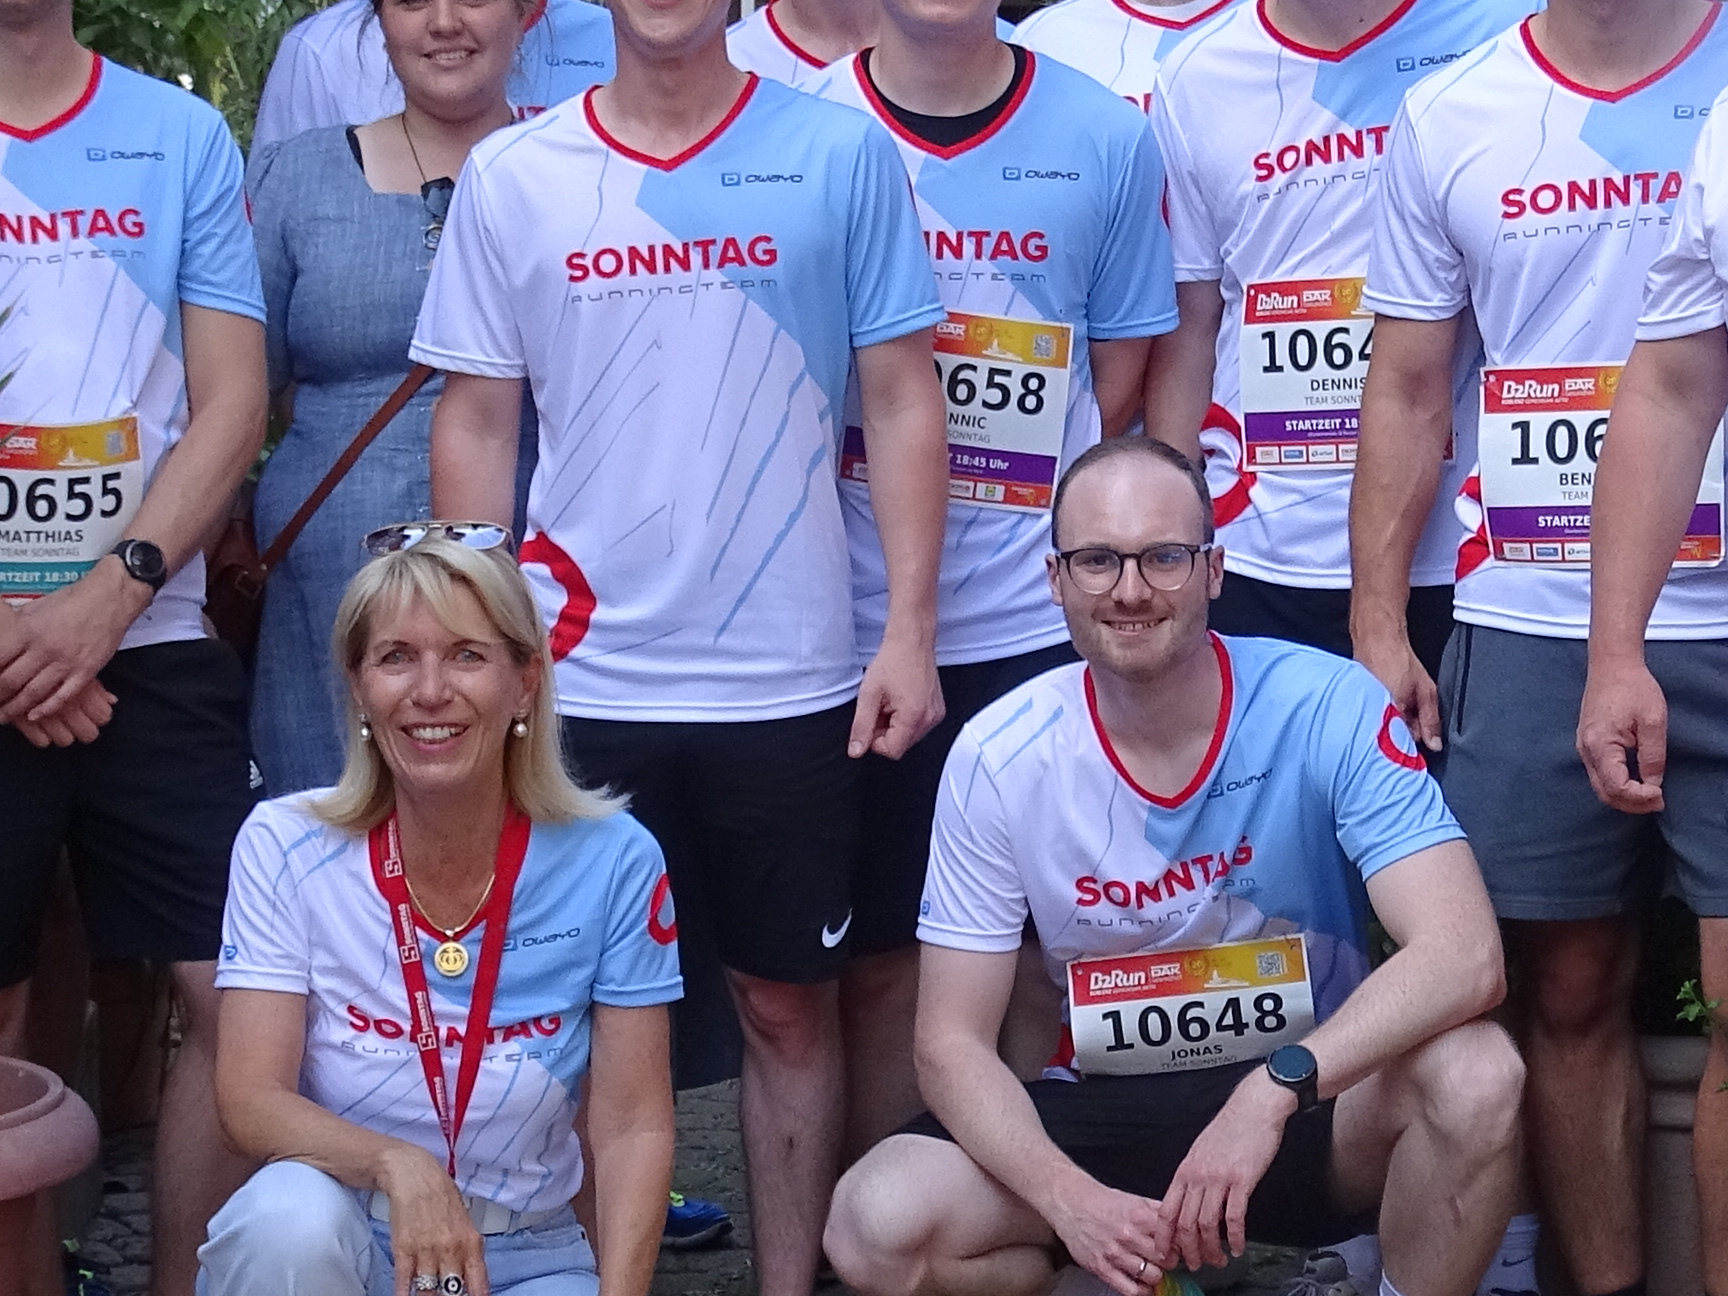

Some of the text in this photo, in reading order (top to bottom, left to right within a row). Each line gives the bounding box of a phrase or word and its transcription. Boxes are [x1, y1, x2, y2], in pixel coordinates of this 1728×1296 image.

[1419, 49, 1471, 67] oway
[744, 174, 804, 184] owayo
[1025, 170, 1081, 181] owayo
[565, 235, 779, 283] SONNTAG
[1310, 376, 1367, 392] DENNIS
[1304, 395, 1329, 406] TEAM
[1285, 418, 1342, 431] STARTZEIT
[955, 453, 987, 468] 18:45
[989, 458, 1010, 471] Uhr
[1561, 490, 1589, 501] TEAM
[0, 547, 81, 557] TEAM SONNTAG
[44, 571, 79, 583] 18:30
[1075, 835, 1253, 911] SONNTAG
[1101, 992, 1287, 1053] 10648
[1170, 1044, 1224, 1062] JONAS
